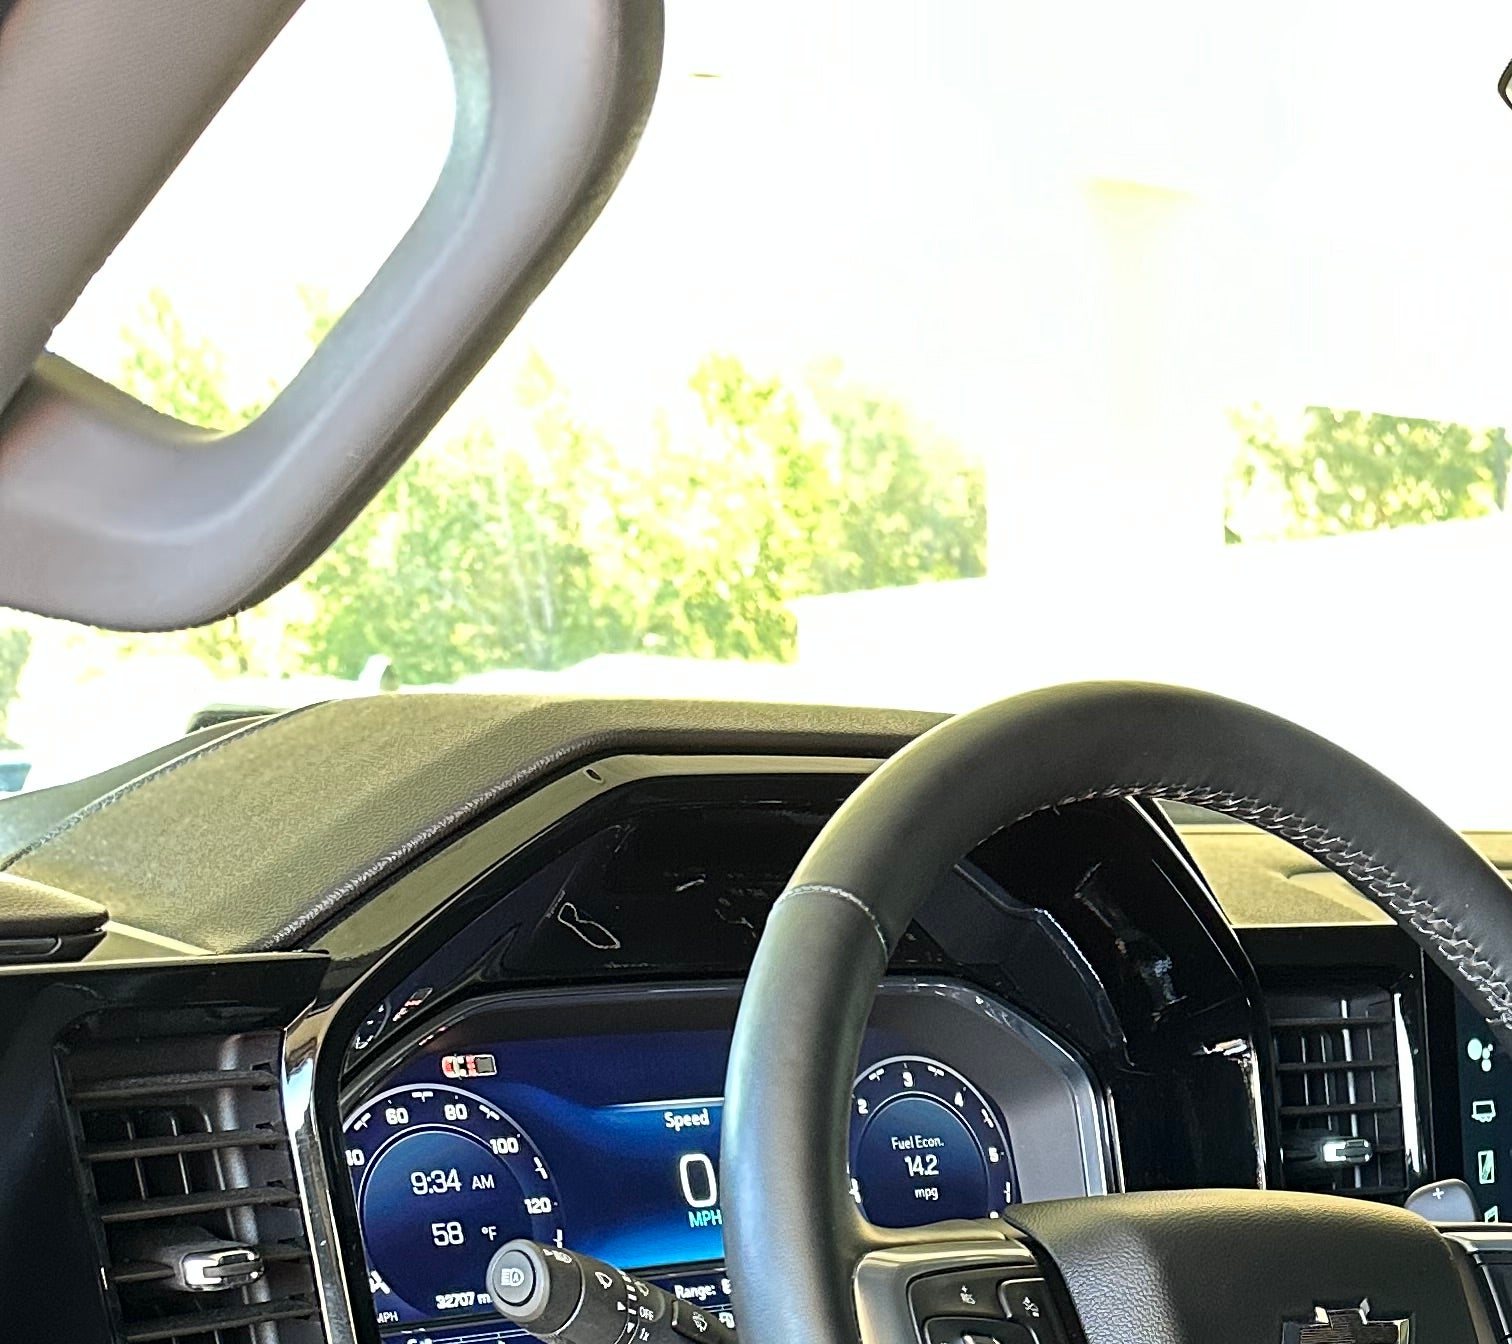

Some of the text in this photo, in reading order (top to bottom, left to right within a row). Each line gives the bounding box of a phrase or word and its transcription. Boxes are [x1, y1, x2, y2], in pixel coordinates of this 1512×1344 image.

[444, 1103, 468, 1121] 80
[857, 1098, 868, 1115] 2
[385, 1107, 409, 1125] 60
[663, 1108, 710, 1132] Speed
[490, 1137, 519, 1155] 100
[891, 1134, 945, 1151] Fuel Econ.
[904, 1153, 940, 1177] 14.2
[410, 1168, 495, 1195] 9:34 AM
[679, 1153, 718, 1208] 0
[914, 1187, 939, 1201] mpg
[524, 1197, 552, 1215] 120
[688, 1209, 723, 1228] MPH
[431, 1221, 465, 1247] 58
[674, 1284, 717, 1301] Range:
[640, 1306, 654, 1321] OFF
